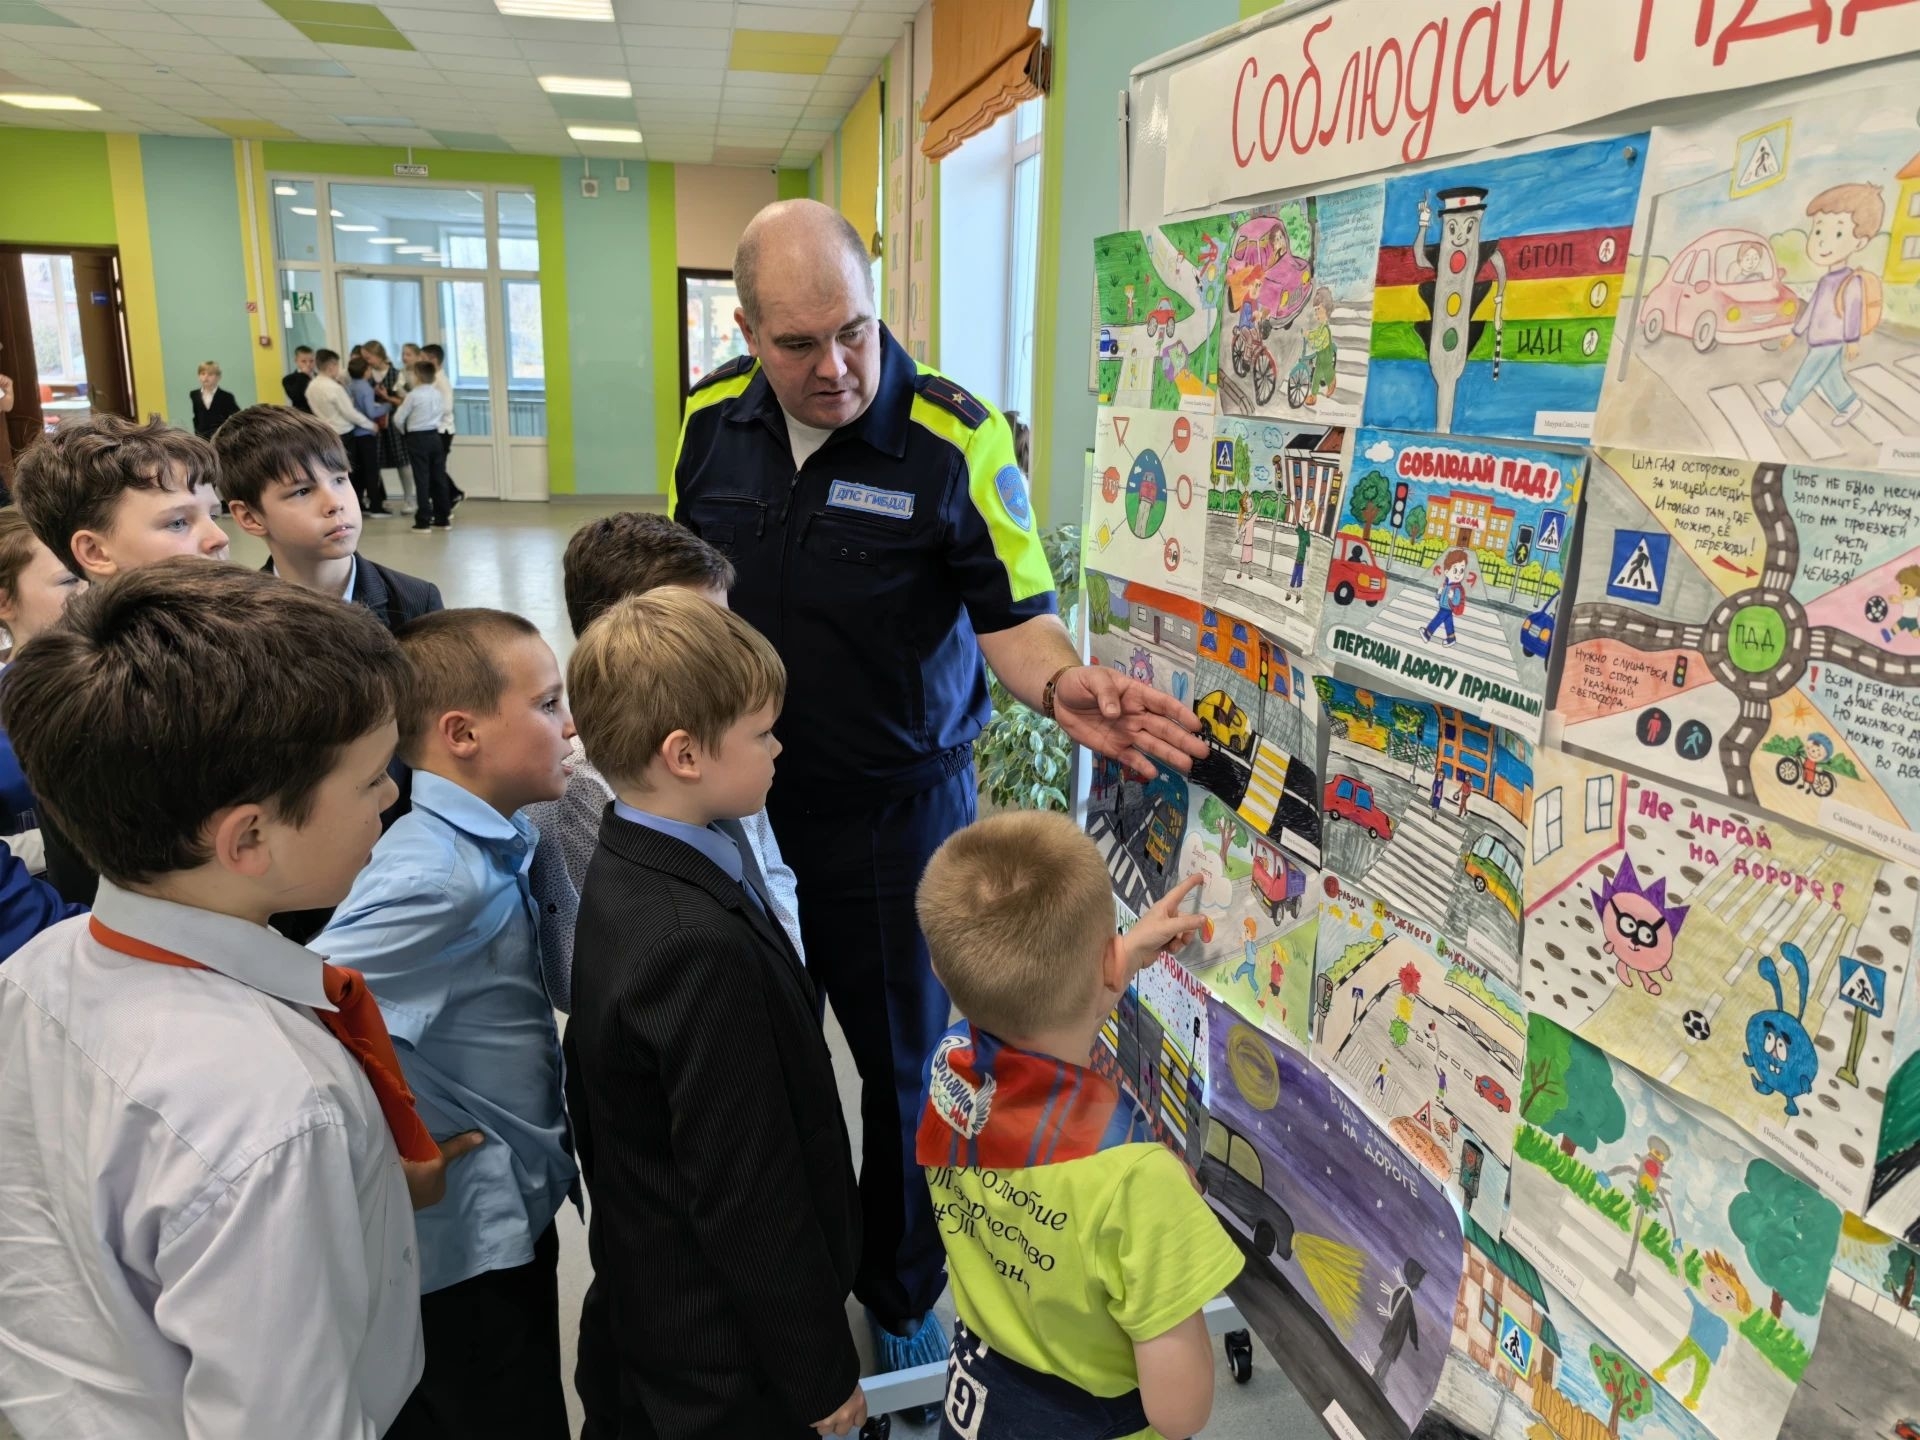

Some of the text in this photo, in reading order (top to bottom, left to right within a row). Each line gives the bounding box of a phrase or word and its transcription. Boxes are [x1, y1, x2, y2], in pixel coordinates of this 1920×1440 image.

[1518, 242, 1574, 271] СТОП
[1517, 325, 1562, 356] ИДИ
[1399, 451, 1561, 499] СОБЛЮДАЙ ПДД!
[1632, 453, 1675, 472] ШАГАЯ
[835, 487, 907, 512] ДПС ГИБДД
[1736, 624, 1775, 653] ПДД
[1333, 629, 1400, 671] ПЕРЕХОДИ
[1401, 654, 1458, 689] ДОРОГУ
[1575, 648, 1607, 664] НУЖНО
[1638, 789, 1674, 822] Не
[1342, 1119, 1358, 1144] НА
[1364, 1141, 1418, 1199] ДОРОГЕ
